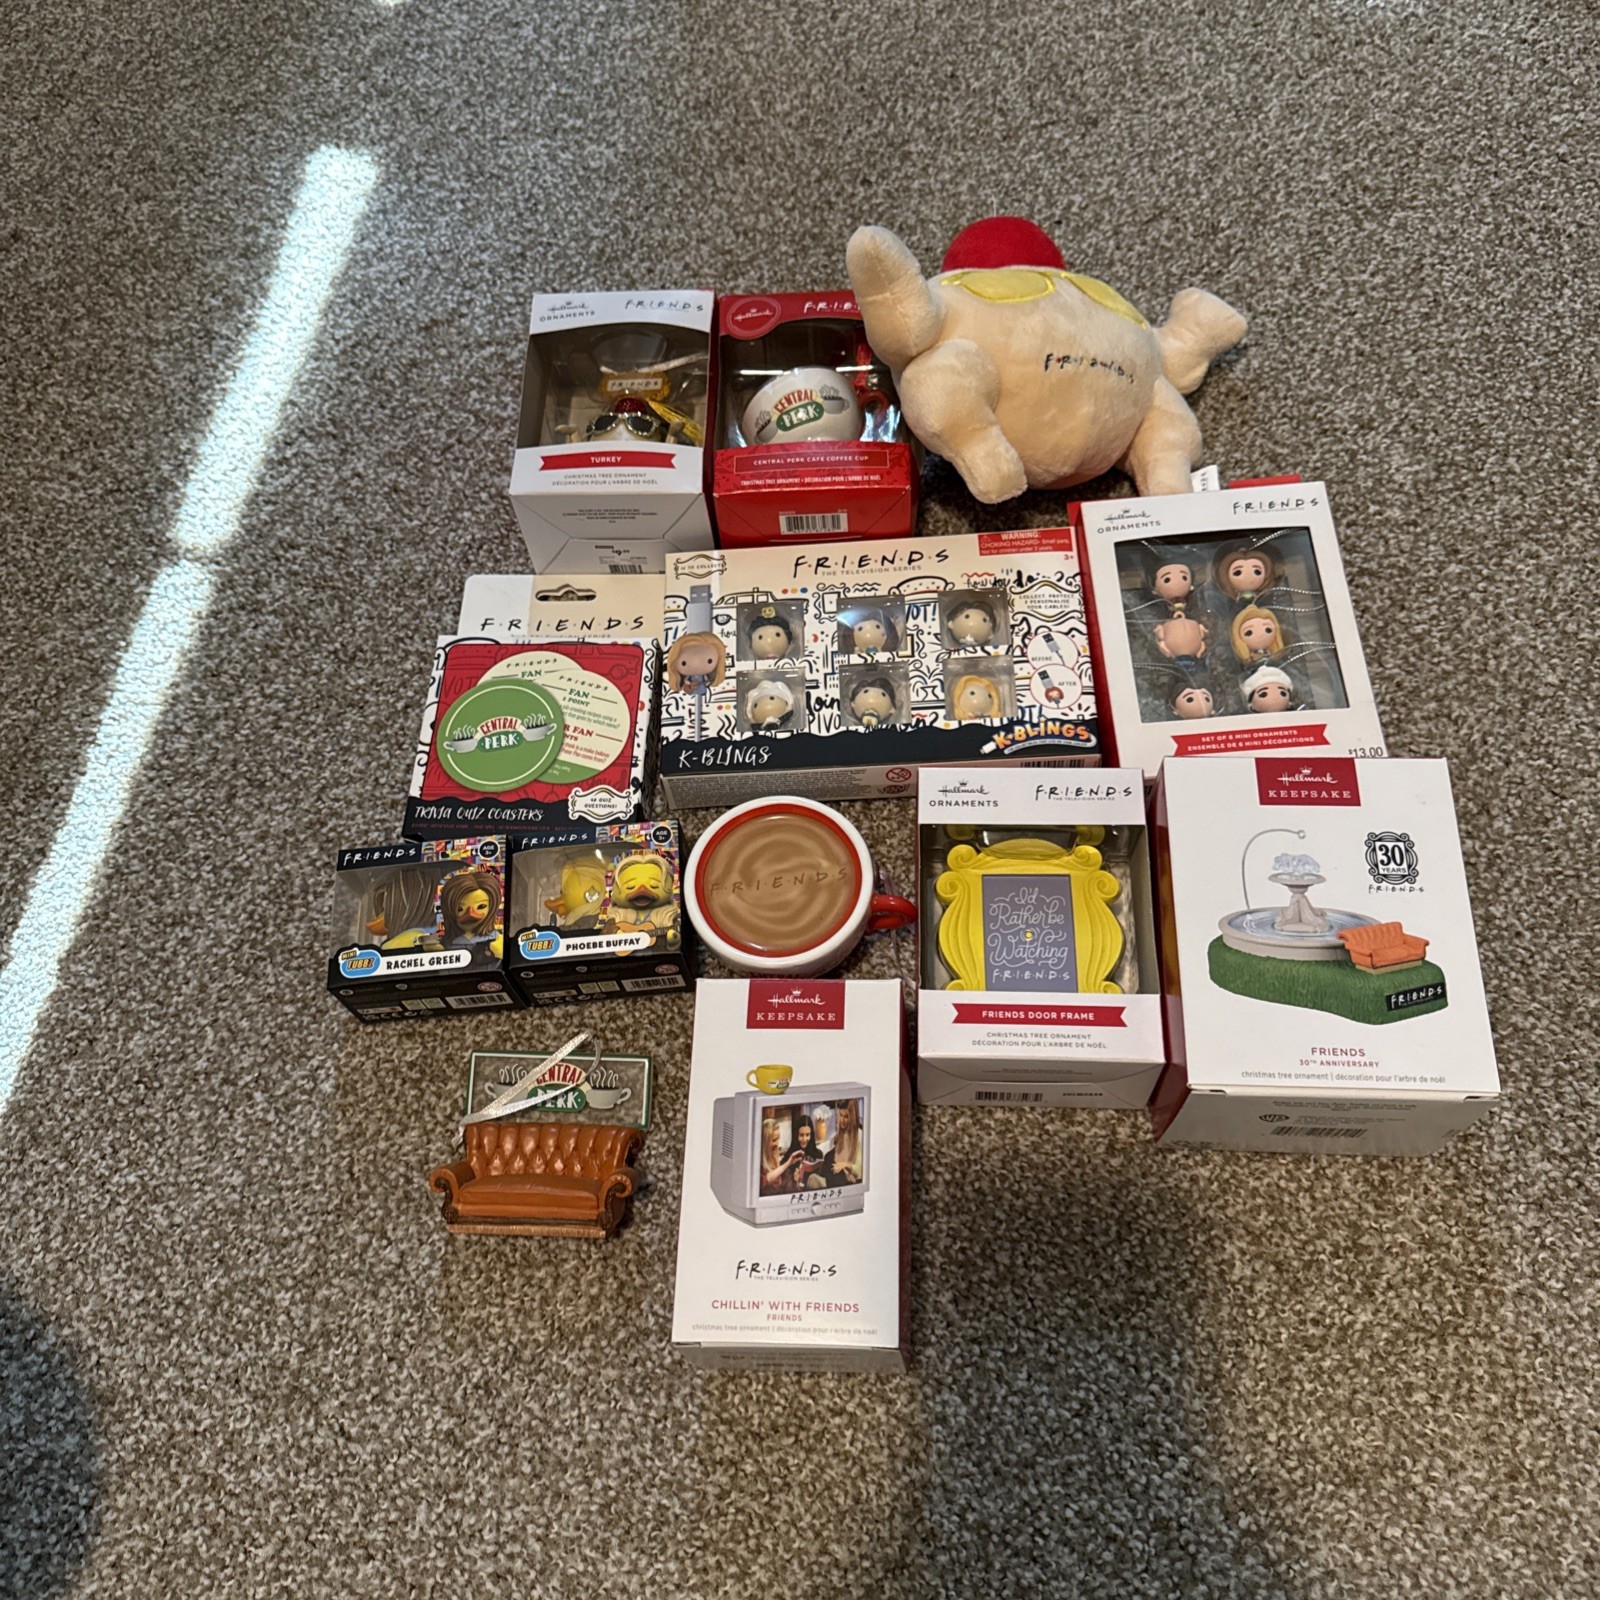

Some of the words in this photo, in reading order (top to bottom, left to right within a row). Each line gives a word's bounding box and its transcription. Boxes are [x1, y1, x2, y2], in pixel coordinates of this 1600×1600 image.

[539, 311, 595, 322] ORNAMENTS
[774, 389, 816, 413] CENTRAL
[782, 404, 820, 428] PERK
[590, 456, 622, 464] TURKEY
[753, 458, 785, 466] CENTRAL
[1097, 520, 1161, 534] ORNAMENTS
[981, 541, 1011, 549] CHOKING
[841, 567, 889, 576] TELEVISION
[520, 669, 543, 678] FAN
[568, 688, 590, 699] FAN
[568, 697, 590, 707] POINT
[480, 717, 519, 736] CENTRAL
[572, 726, 594, 737] FAN
[1252, 729, 1298, 738] ORNAMENTS
[484, 732, 519, 750] PERK
[1187, 743, 1225, 751] ENSEMBLE
[1262, 735, 1315, 746] DÉCORATIONS
[678, 745, 773, 769] K-BLINGS
[1276, 772, 1338, 786] Hallmark
[938, 784, 990, 797] Hallmark
[1268, 790, 1352, 799] KEEPSAKE
[929, 800, 999, 808] ORNAMENTS
[457, 806, 485, 820] QUIZ
[487, 806, 545, 822] COASTERS
[1377, 844, 1405, 867] 30
[989, 902, 1045, 933] Rather
[1044, 899, 1065, 927] be
[526, 939, 555, 951] TUBBZ
[566, 940, 604, 951] PHOEBE
[606, 937, 641, 948] BUFFAY
[987, 929, 1069, 970] Watching
[341, 950, 357, 960] MINI
[346, 959, 375, 971] TUBBZ
[386, 956, 425, 970] RACHEL
[428, 954, 462, 966] GREEN
[767, 993, 826, 1008] Hallmark
[756, 1012, 837, 1021] KEEPSAKE
[982, 1010, 1025, 1019] FRIENDS
[1028, 1011, 1057, 1020] DOOR
[1060, 1012, 1095, 1021] FRAME
[986, 1031, 1028, 1039] CHRISTMAS
[971, 1038, 1019, 1047] DÉCORATION
[1087, 1041, 1107, 1049] NOËL
[1311, 1047, 1366, 1057] FRIENDS
[1319, 1059, 1380, 1068] ANNIVERSARY
[1241, 1071, 1276, 1079] christmas
[1294, 1072, 1329, 1080] ornament
[1335, 1072, 1374, 1081] décoration
[1375, 1075, 1392, 1083] pour
[1429, 1075, 1446, 1083] noël
[711, 1299, 765, 1311] CHILLIN'
[768, 1301, 801, 1311] WITH
[806, 1302, 860, 1313] FRIENDS
[766, 1314, 803, 1322] FRIENDS
[692, 1323, 723, 1332] christmas
[813, 1327, 829, 1335] pour
